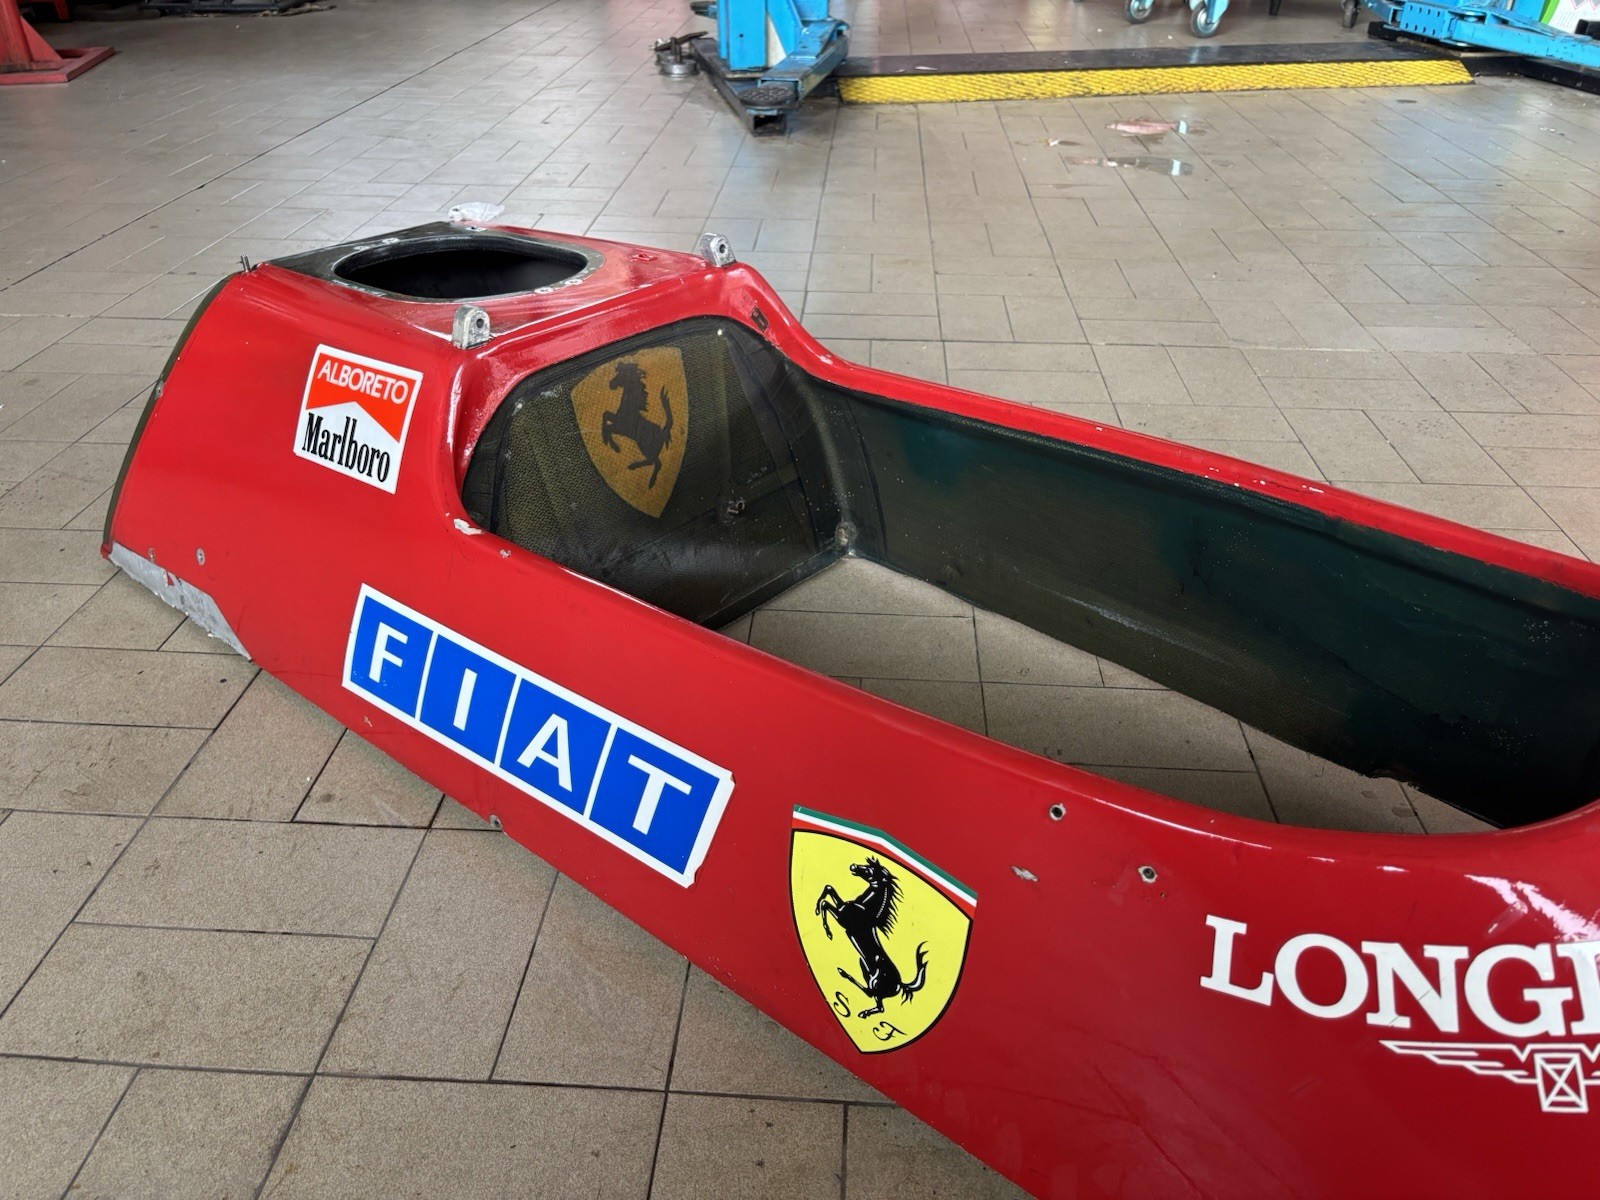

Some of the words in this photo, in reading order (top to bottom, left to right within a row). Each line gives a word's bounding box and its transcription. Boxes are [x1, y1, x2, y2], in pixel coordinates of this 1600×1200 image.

[317, 359, 409, 405] ALBORETO
[302, 412, 391, 483] Marlboro
[369, 621, 693, 836] FIAT
